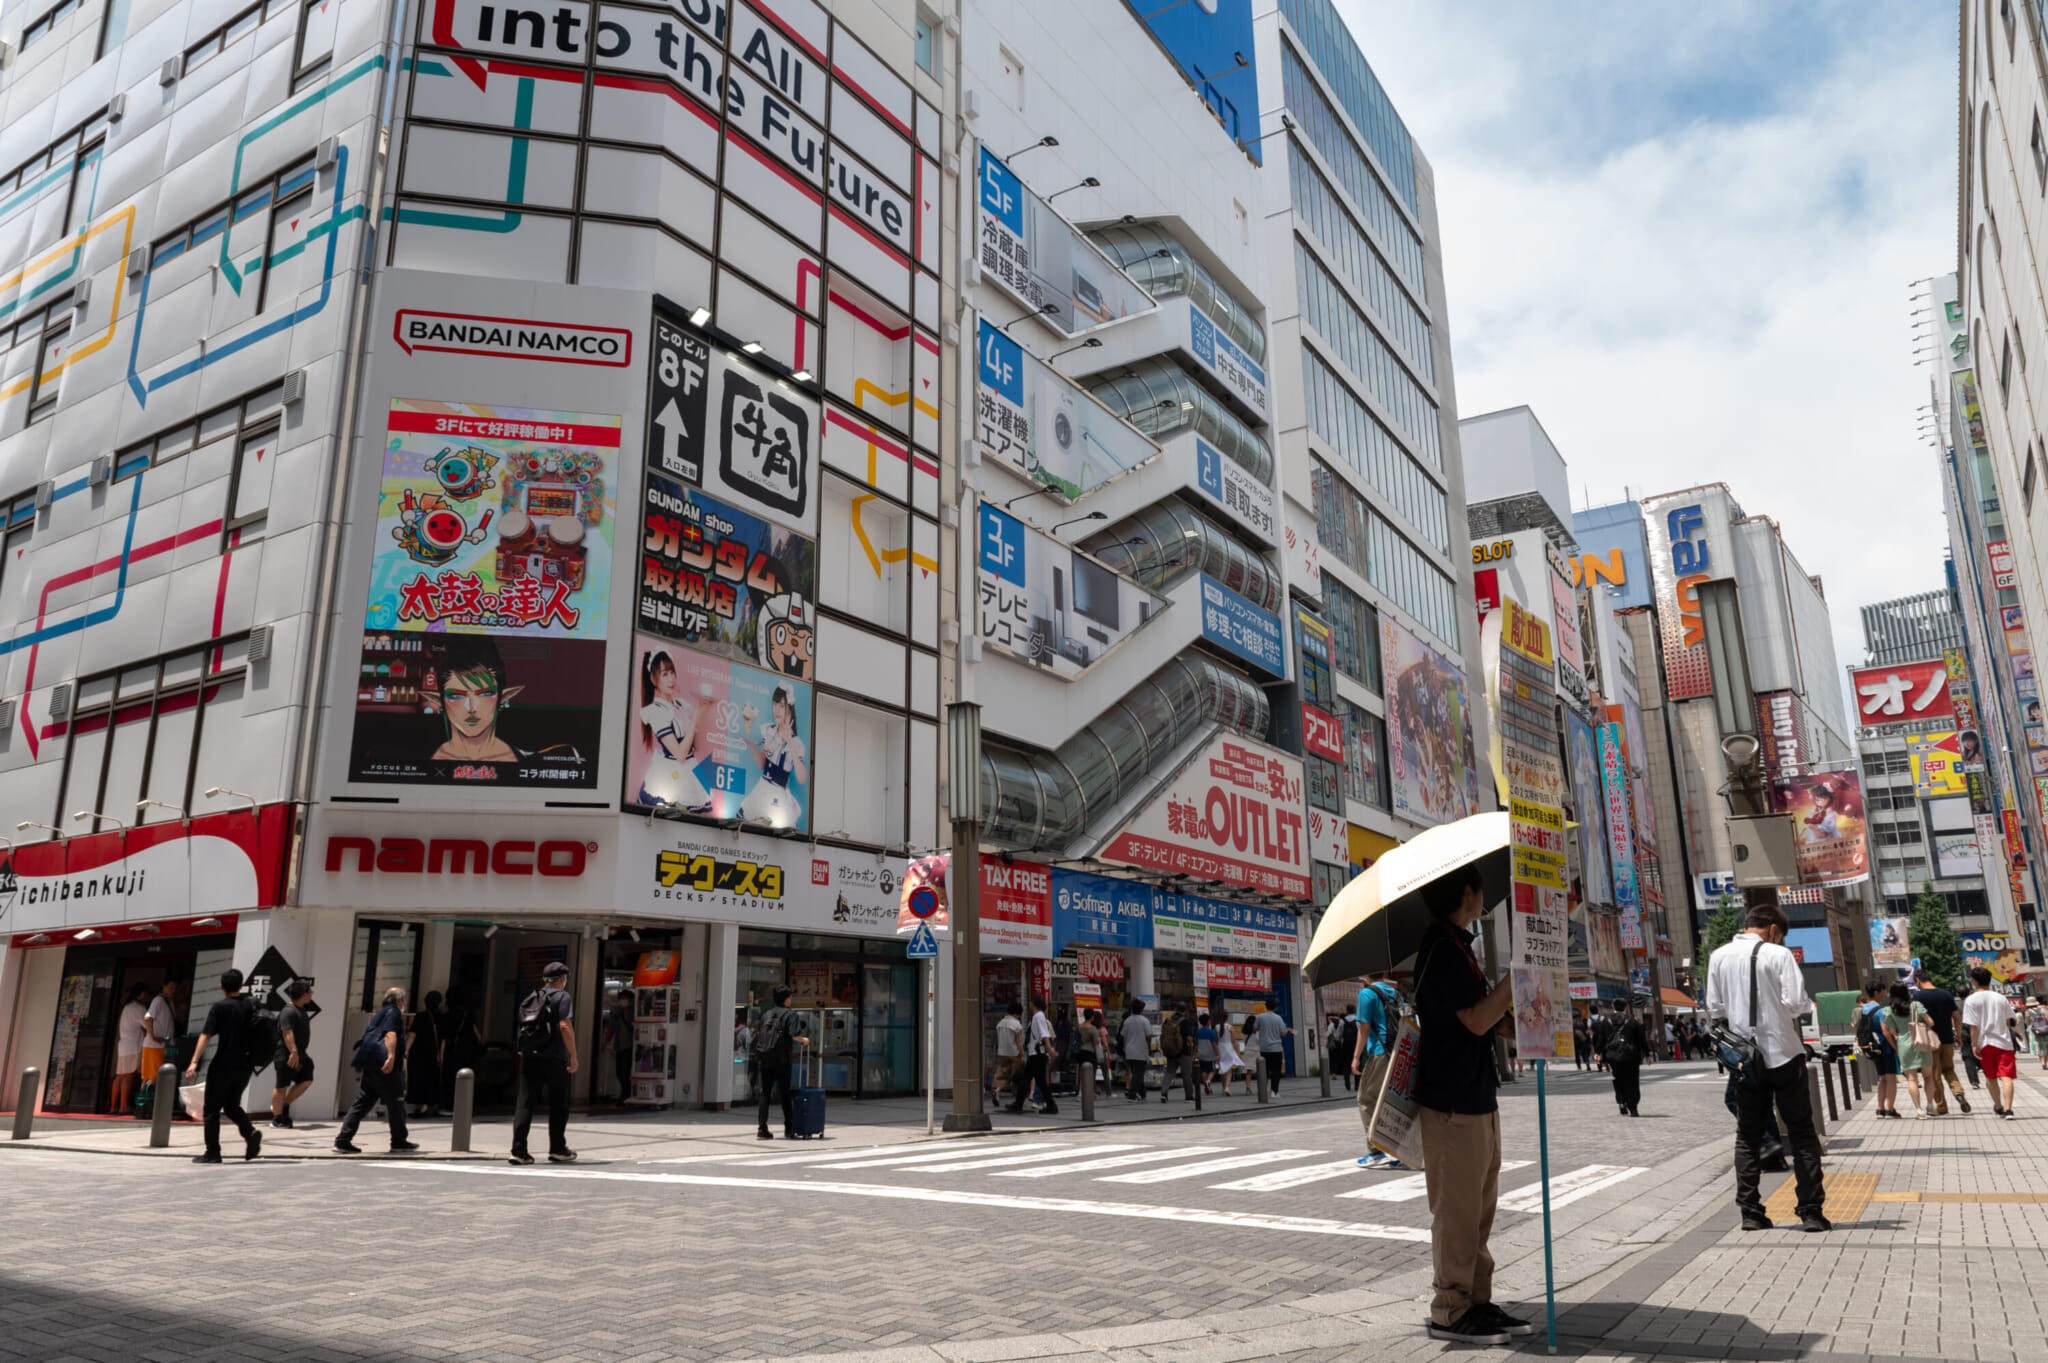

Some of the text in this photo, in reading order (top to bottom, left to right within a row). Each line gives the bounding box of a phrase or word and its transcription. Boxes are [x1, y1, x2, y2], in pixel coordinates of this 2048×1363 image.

[742, 28, 803, 103] All
[477, 4, 902, 235] into the Future
[986, 160, 1013, 214] 5F
[982, 214, 1029, 270] 冷蔵庫
[982, 243, 1044, 307] 調理家電
[409, 321, 619, 356] BANDAI NAMCO
[659, 326, 707, 361] このビル
[986, 334, 1013, 386] 4F
[658, 348, 704, 396] 8F
[1217, 353, 1265, 410] 中古専門店
[979, 392, 1028, 444] 洗濯機
[734, 401, 798, 489] 牛角
[981, 424, 1040, 473] エアコン
[1202, 451, 1217, 489] 2F
[648, 488, 734, 535] GUNDAM shop
[646, 514, 776, 595] ガンダム
[986, 513, 1015, 568] 3F
[1472, 540, 1513, 563] SLOT
[397, 570, 580, 629] 太鼓の達人
[643, 556, 737, 620] 取扱店
[981, 580, 1027, 623] テレビ
[1999, 574, 2014, 586] 6F
[641, 596, 708, 633] 当ビル7F
[982, 611, 1058, 658] レコーダー
[1205, 604, 1265, 660] 修理・ご相談
[1511, 602, 1544, 658] 献血
[1859, 669, 1946, 716] オノ
[1305, 712, 1340, 754] アコム
[1761, 698, 1776, 761] Flagship Store
[1771, 696, 1799, 777] Duty Free
[370, 764, 401, 772] FOCUS
[519, 768, 586, 781] コラボ開催中！
[716, 765, 735, 790] 6F
[677, 841, 700, 851] BANDAI
[702, 845, 719, 854] CARD
[720, 848, 743, 857] GAMES
[20, 869, 145, 905] ichibankuji
[838, 866, 877, 882] ガシャポン
[983, 864, 1048, 894] TAX FREE
[654, 889, 785, 910] DECKS STADIUM
[1072, 893, 1147, 919] Sofmap AKIBA
[1526, 915, 1563, 934] 献血カード
